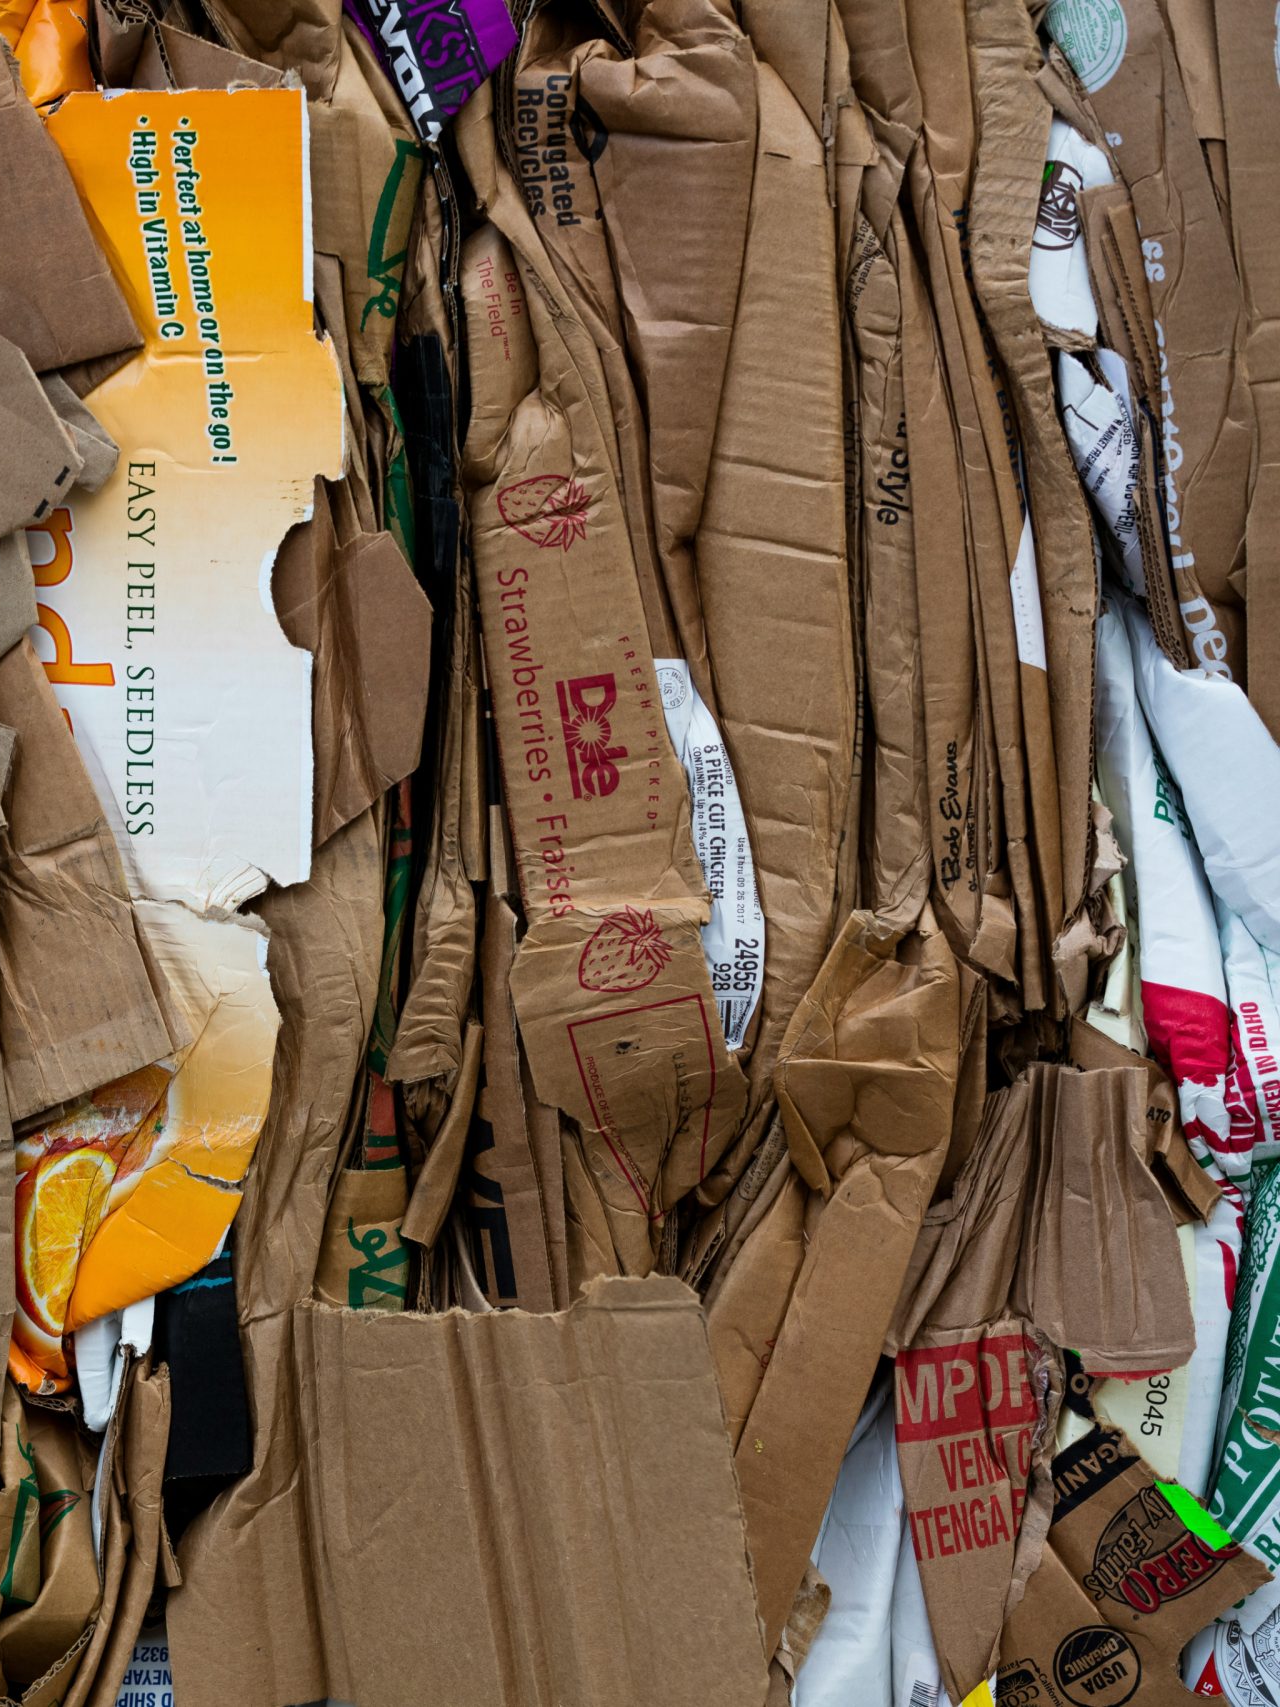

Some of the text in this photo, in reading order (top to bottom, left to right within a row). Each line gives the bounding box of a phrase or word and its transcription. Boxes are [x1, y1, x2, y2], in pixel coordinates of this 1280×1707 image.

[517, 88, 546, 219] Recycles
[546, 74, 581, 226] Corrugated
[130, 131, 184, 338] High in Vitamin C
[855, 220, 869, 244] 2015
[173, 131, 237, 463] Perfect at home or on the go!
[475, 256, 506, 338] The Field
[504, 272, 517, 293] Be
[1097, 424, 1119, 449] MARKET
[124, 461, 155, 836] EASY PEEL, SEEDLESS
[671, 671, 687, 707] INSPECTED
[497, 567, 575, 918] Strawberries Fraises
[567, 672, 628, 798] Dole
[618, 635, 659, 820] FRESH PICKED
[704, 745, 726, 900] 8 PIECE CUT CHICKEN
[939, 740, 962, 890] Bob Evans
[737, 855, 745, 876] Thru
[737, 877, 745, 887] 09
[737, 903, 745, 924] 2017
[713, 963, 732, 991] 928
[733, 938, 759, 992] 24955
[1239, 1002, 1268, 1052] IDAHO
[585, 1055, 606, 1100] PRODUCE
[599, 1099, 610, 1113] OF
[1253, 1055, 1277, 1075] IN
[1140, 1376, 1169, 1437] 3045
[909, 1494, 1011, 1561] TENGA
[1083, 1519, 1153, 1601] Farms
[1120, 1532, 1244, 1615] ERO
[1064, 1637, 1120, 1678] ORGANIC
[1080, 1661, 1129, 1696] USDA
